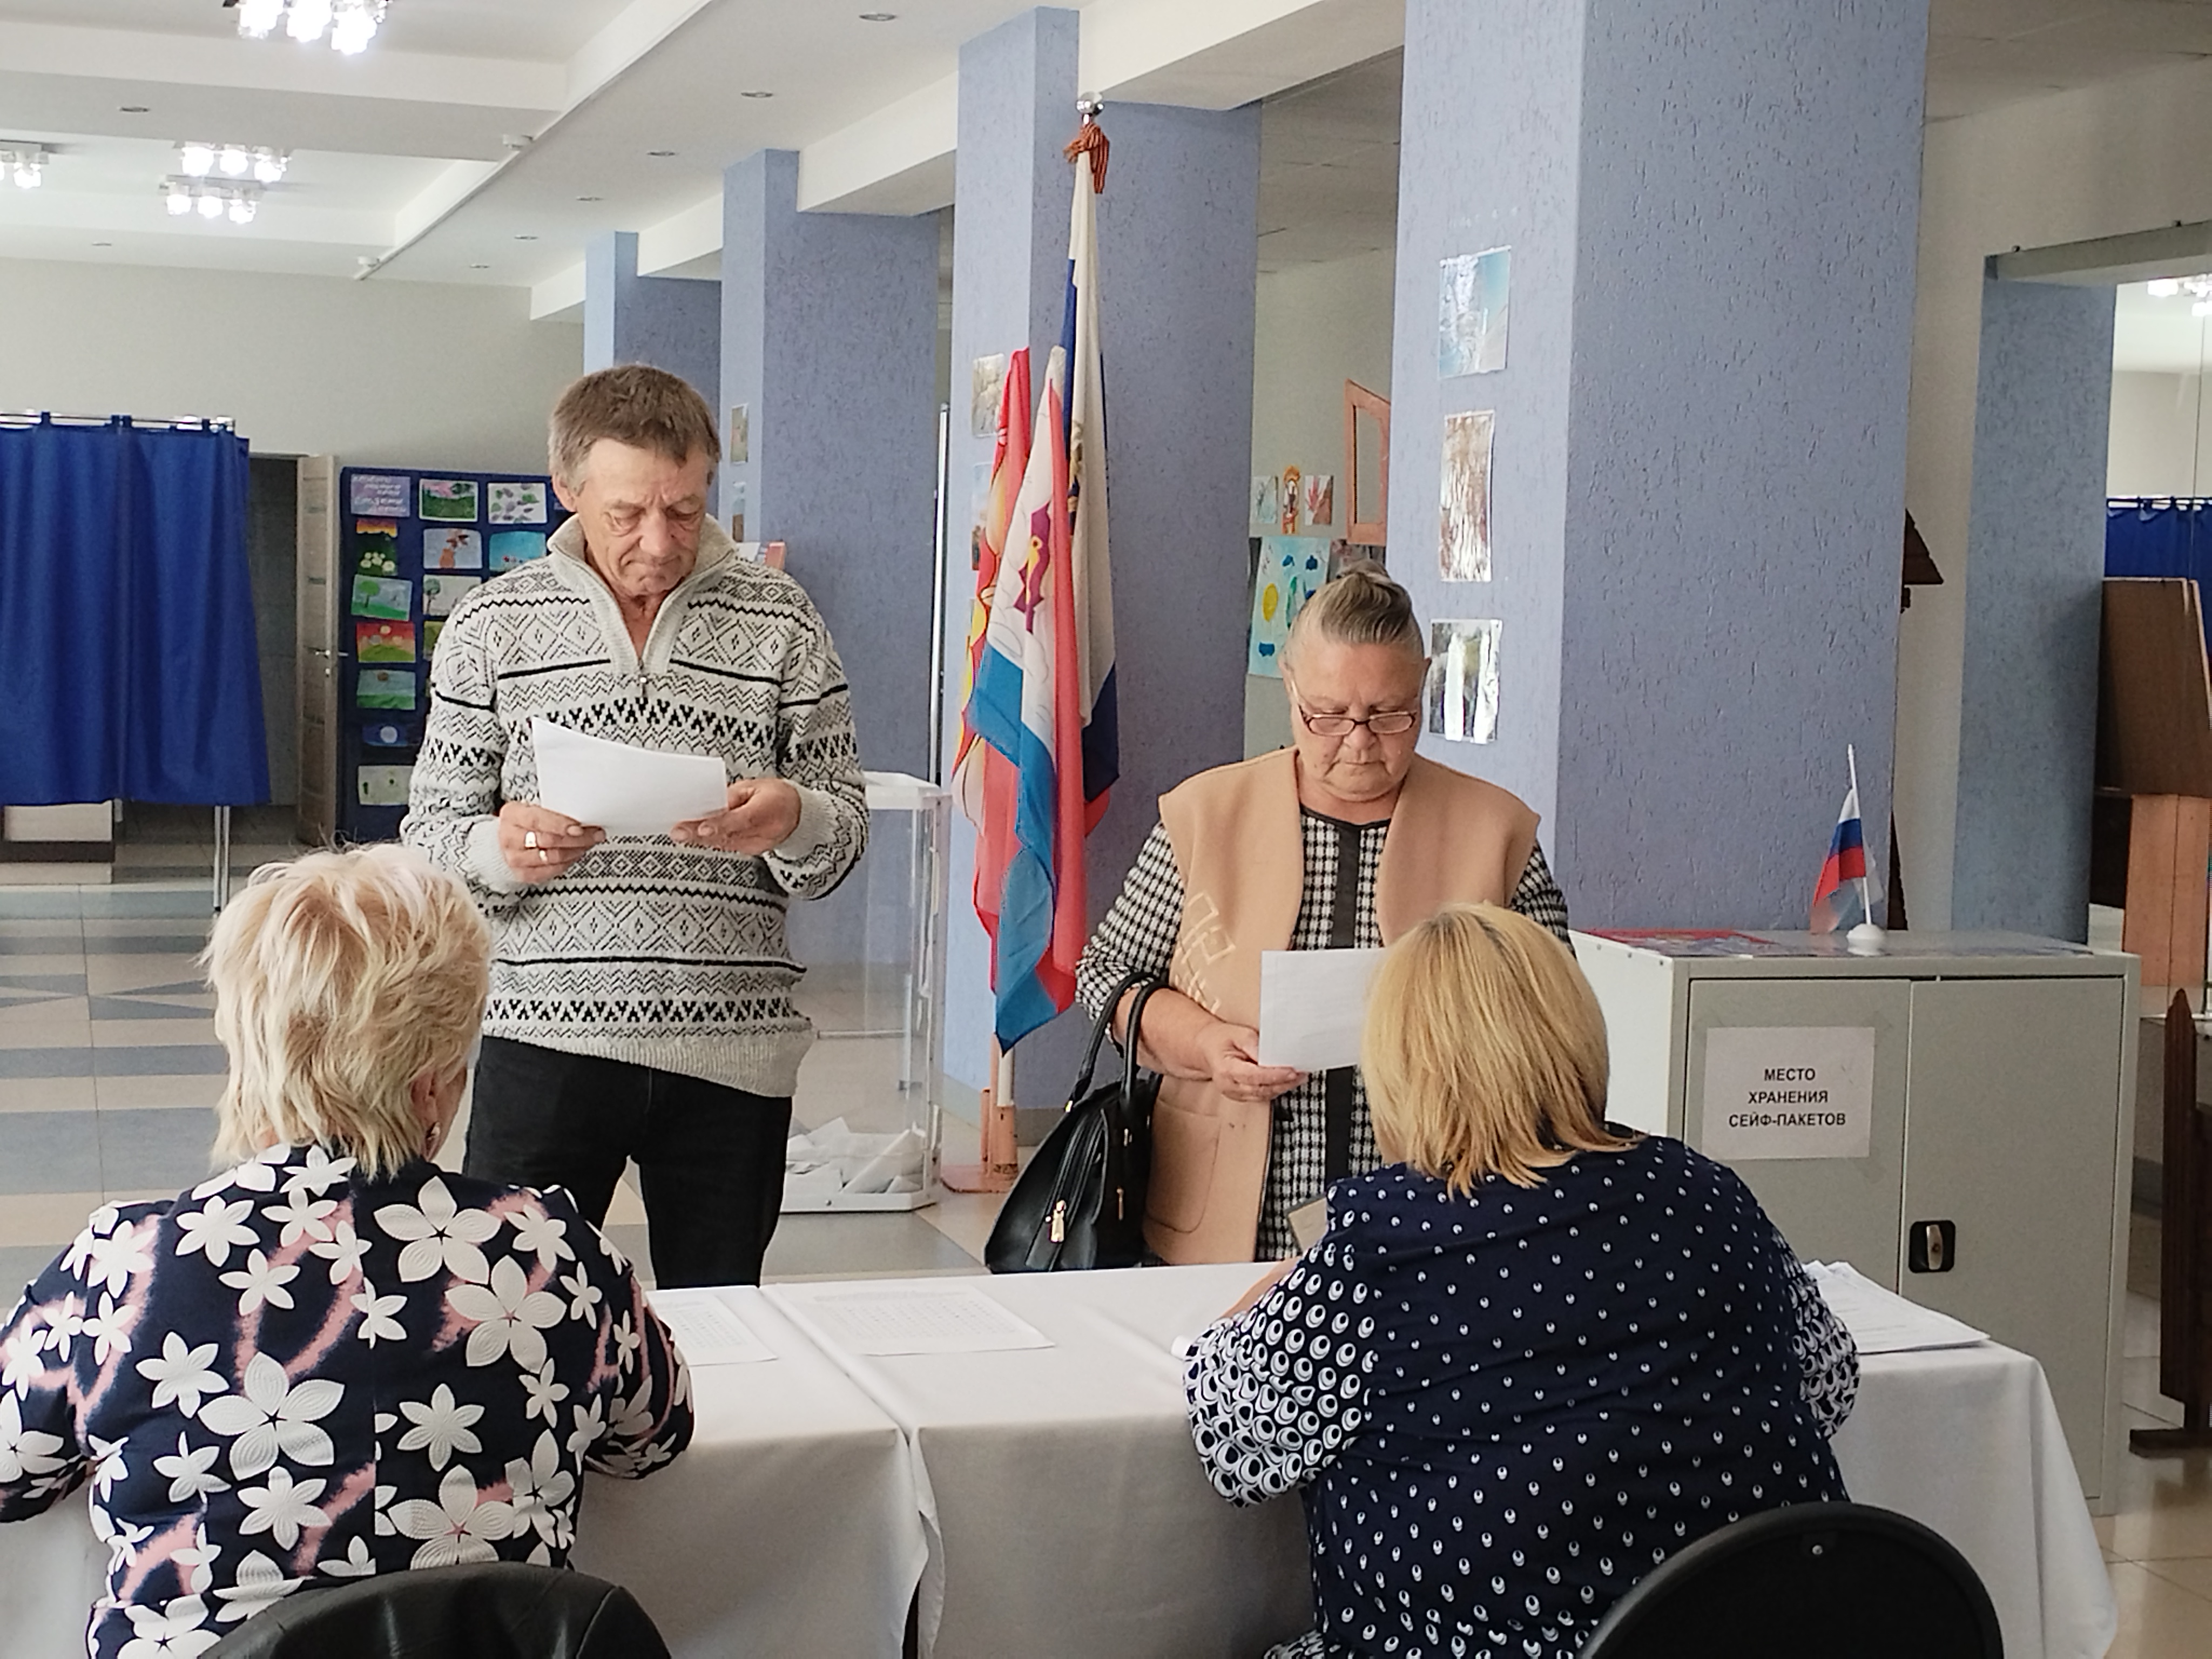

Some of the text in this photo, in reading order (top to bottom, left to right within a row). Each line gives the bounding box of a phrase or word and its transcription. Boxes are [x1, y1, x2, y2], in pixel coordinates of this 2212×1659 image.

[1764, 1068, 1816, 1081] МЕСТО
[1748, 1090, 1828, 1104] ХРАНЕНИЯ
[1729, 1111, 1846, 1127] СЕЙФ-ПАКЕТОВ
